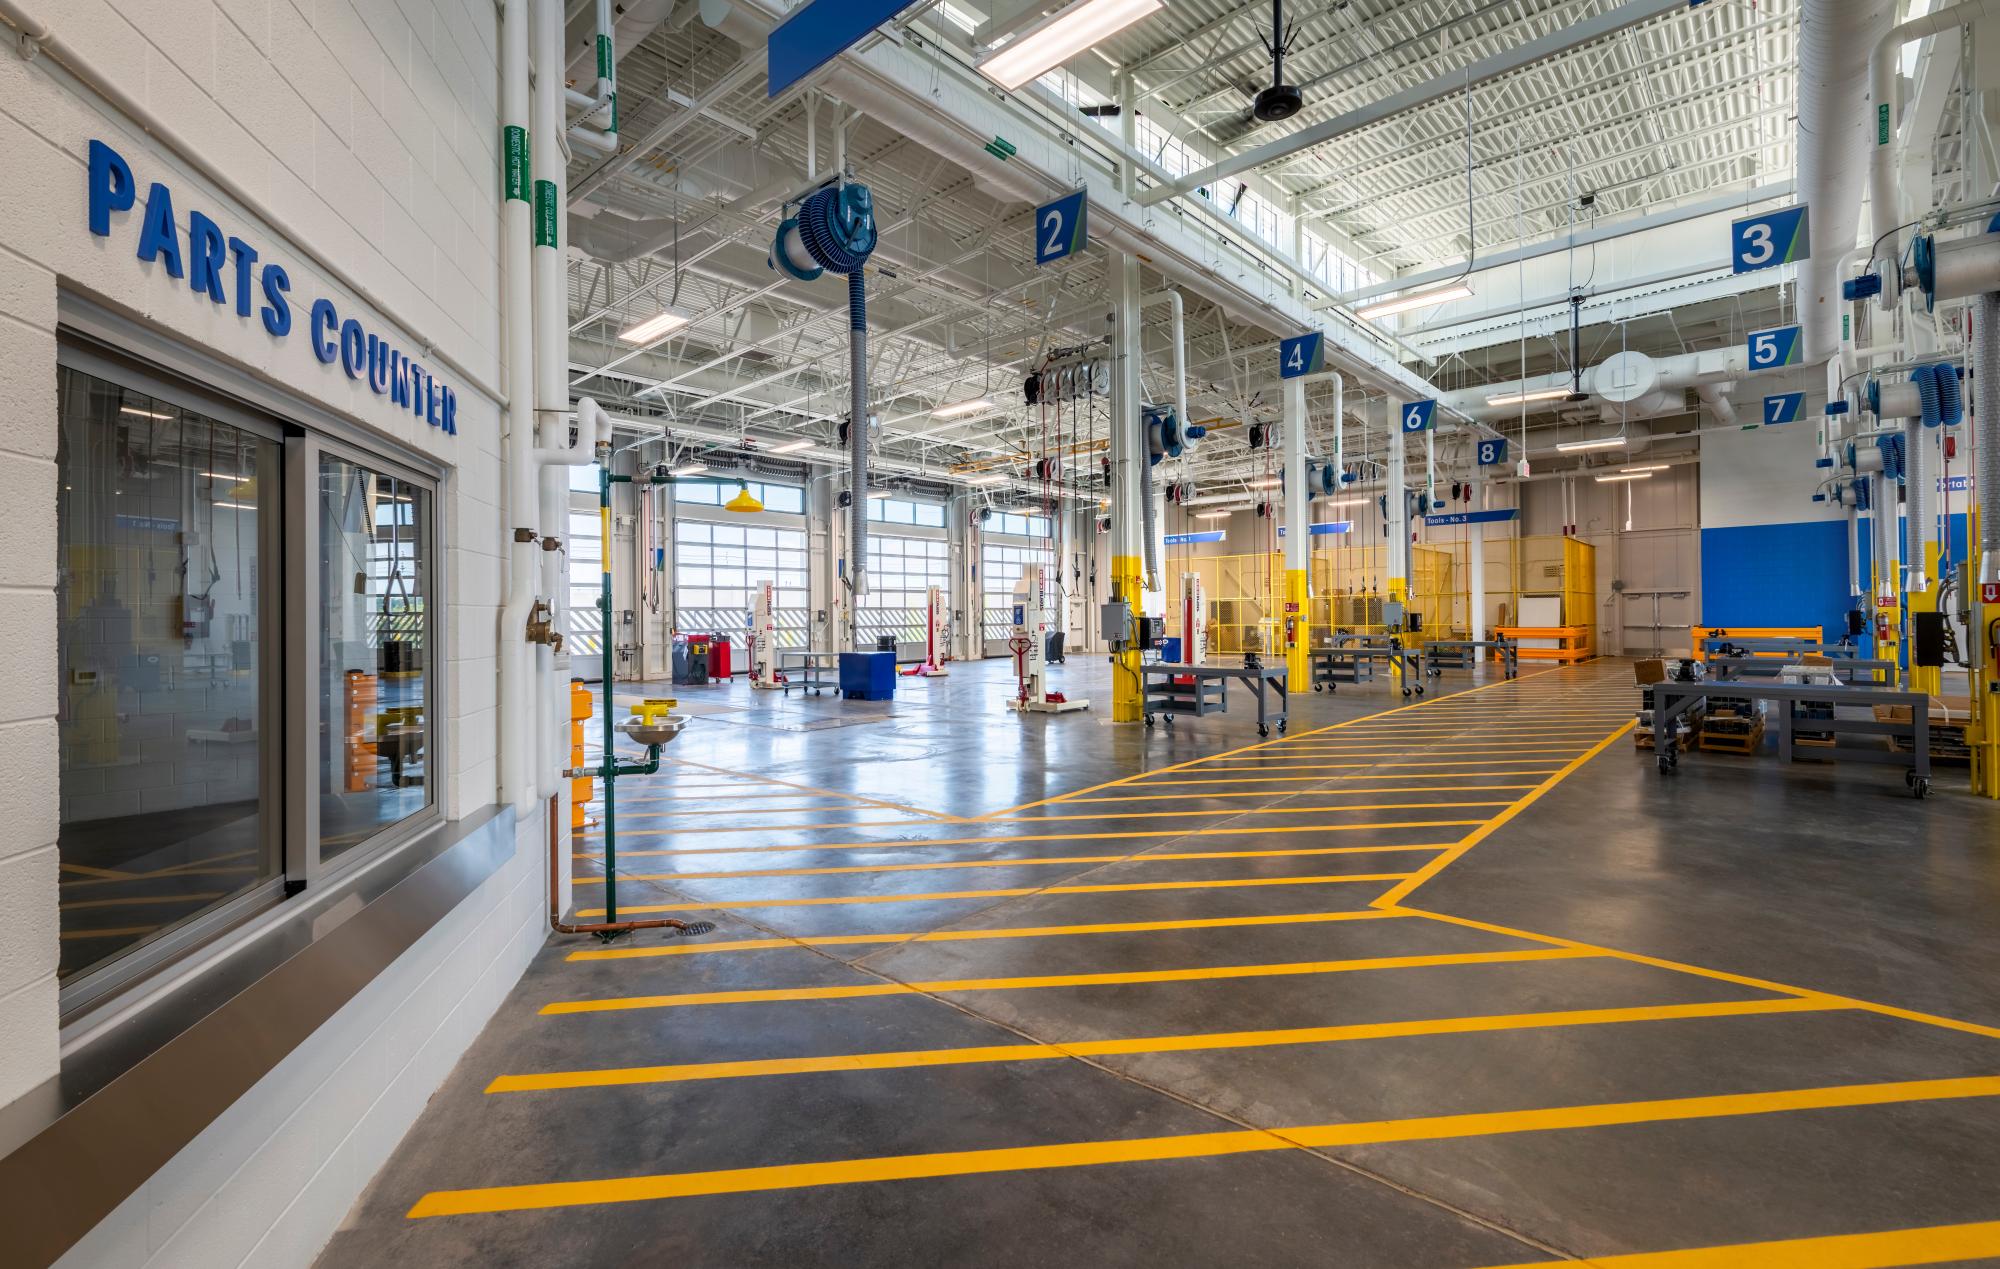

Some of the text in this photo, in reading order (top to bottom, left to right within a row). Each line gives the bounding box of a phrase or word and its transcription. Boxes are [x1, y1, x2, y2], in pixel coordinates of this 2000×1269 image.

[511, 127, 521, 156] DOMESTIC
[1044, 210, 1063, 256] 2
[1742, 223, 1774, 264] 3
[89, 140, 457, 435] PARTS COUNTER
[1288, 343, 1303, 370] 4
[1755, 334, 1777, 363] 5
[1406, 406, 1421, 428] 6
[1769, 399, 1786, 421] 7
[1481, 444, 1494, 462] 8
